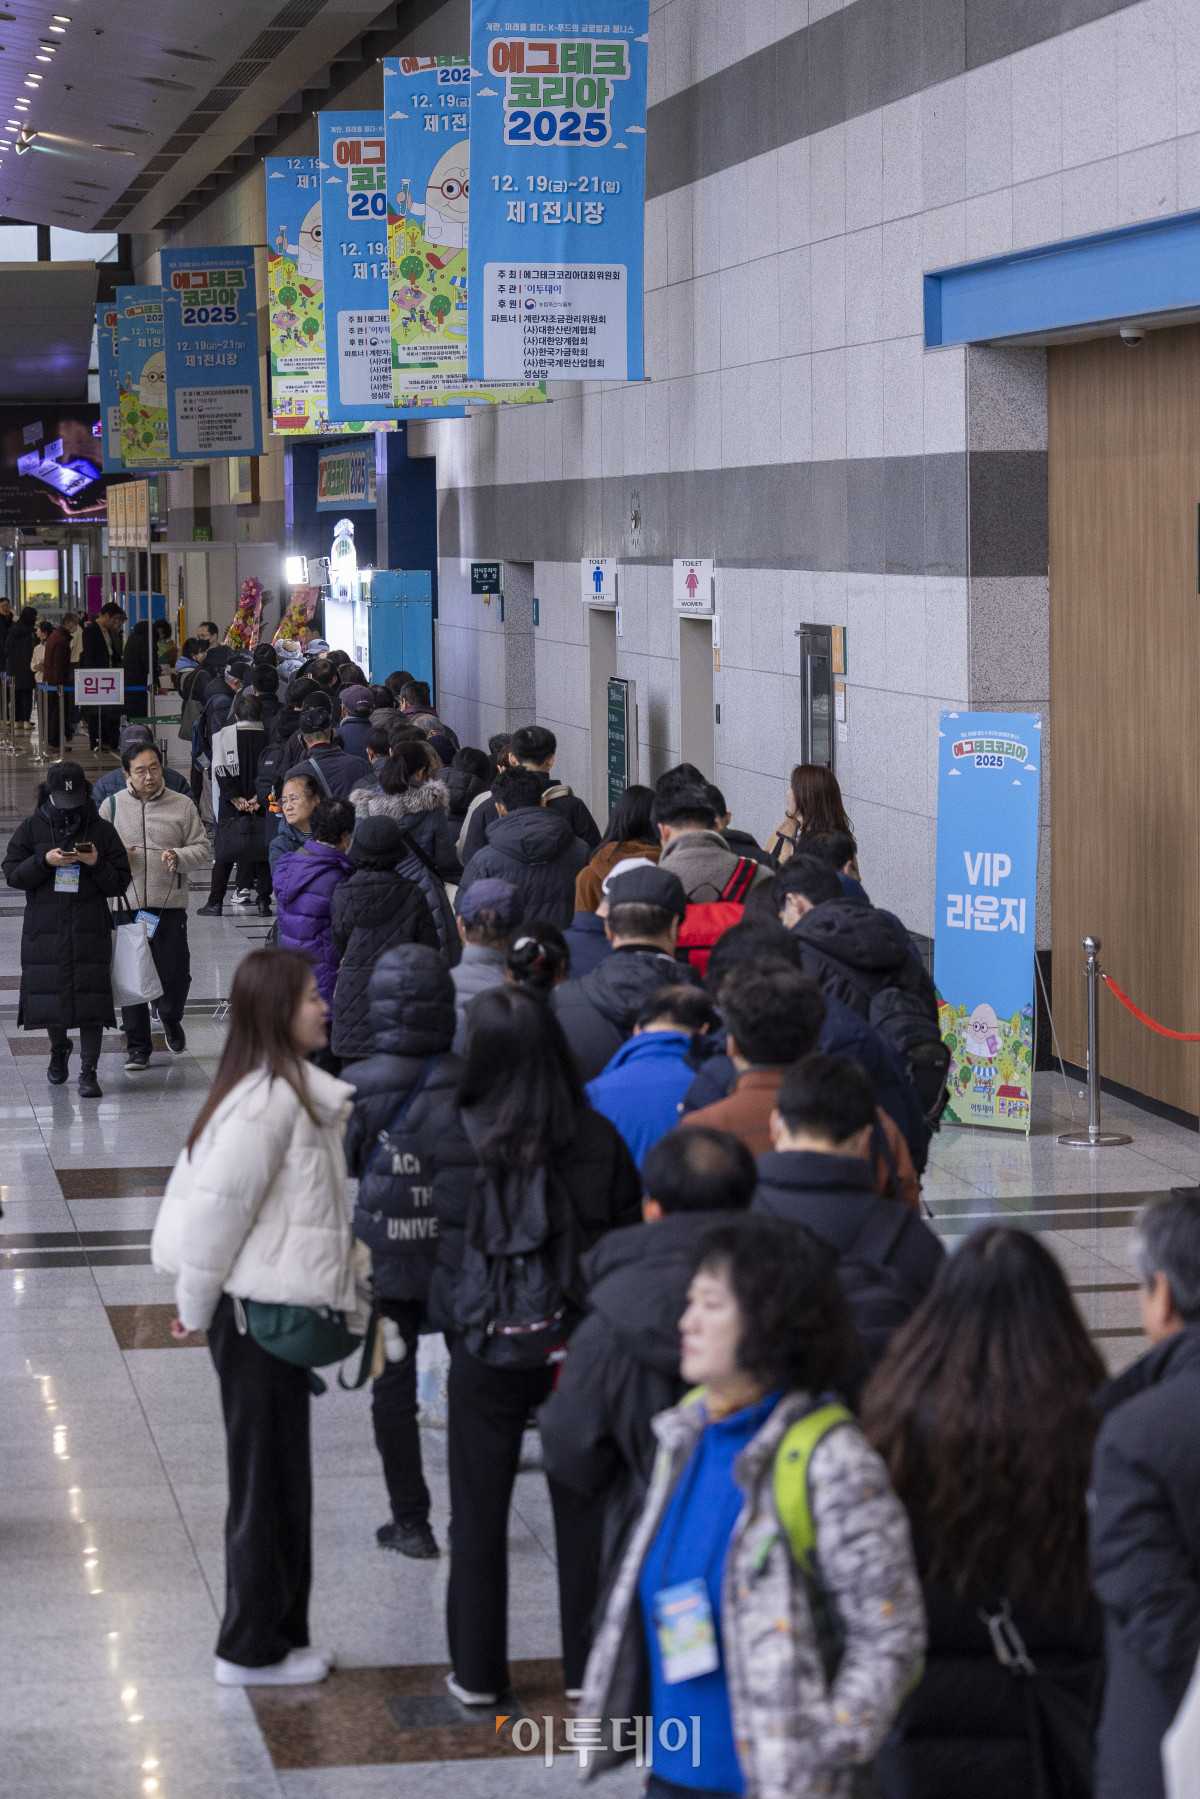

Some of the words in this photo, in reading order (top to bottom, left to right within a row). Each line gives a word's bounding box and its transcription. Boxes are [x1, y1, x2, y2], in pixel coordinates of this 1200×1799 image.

[492, 42, 626, 75] 에그테크
[508, 77, 609, 109] 코리아
[412, 95, 432, 108] 12.
[508, 111, 607, 141] 2025
[287, 159, 304, 169] 12.
[491, 175, 518, 192] 12.
[526, 175, 620, 194] 19(금)~21(일)
[506, 200, 604, 225] 제1전시장
[340, 243, 361, 256] 12.
[173, 270, 245, 289] 에그테크
[523, 270, 620, 281] 에그테크코리아대회위원회
[527, 284, 562, 295] 이투데이
[183, 288, 236, 307] 코리아
[184, 307, 237, 324] 2025
[491, 314, 517, 324] 파트너
[523, 314, 606, 324] 계란자조금관리위원회
[523, 325, 596, 335] (사)대한산란계협회
[177, 341, 191, 351] 12.
[523, 336, 588, 346] (사)대한양계협회
[369, 349, 391, 357] 계란자
[523, 347, 588, 357] (사)한국가금학회
[185, 353, 239, 368] 제1전시장
[523, 358, 605, 368] (사)한국계란산업협회
[523, 369, 549, 379] 성심당
[84, 677, 116, 694] 입구
[953, 740, 1027, 760] 에그테크코리아
[976, 755, 1003, 767] 2025
[963, 851, 1012, 887] VIP
[946, 894, 1026, 934] 라운지
[386, 1217, 438, 1240] UNIVE
